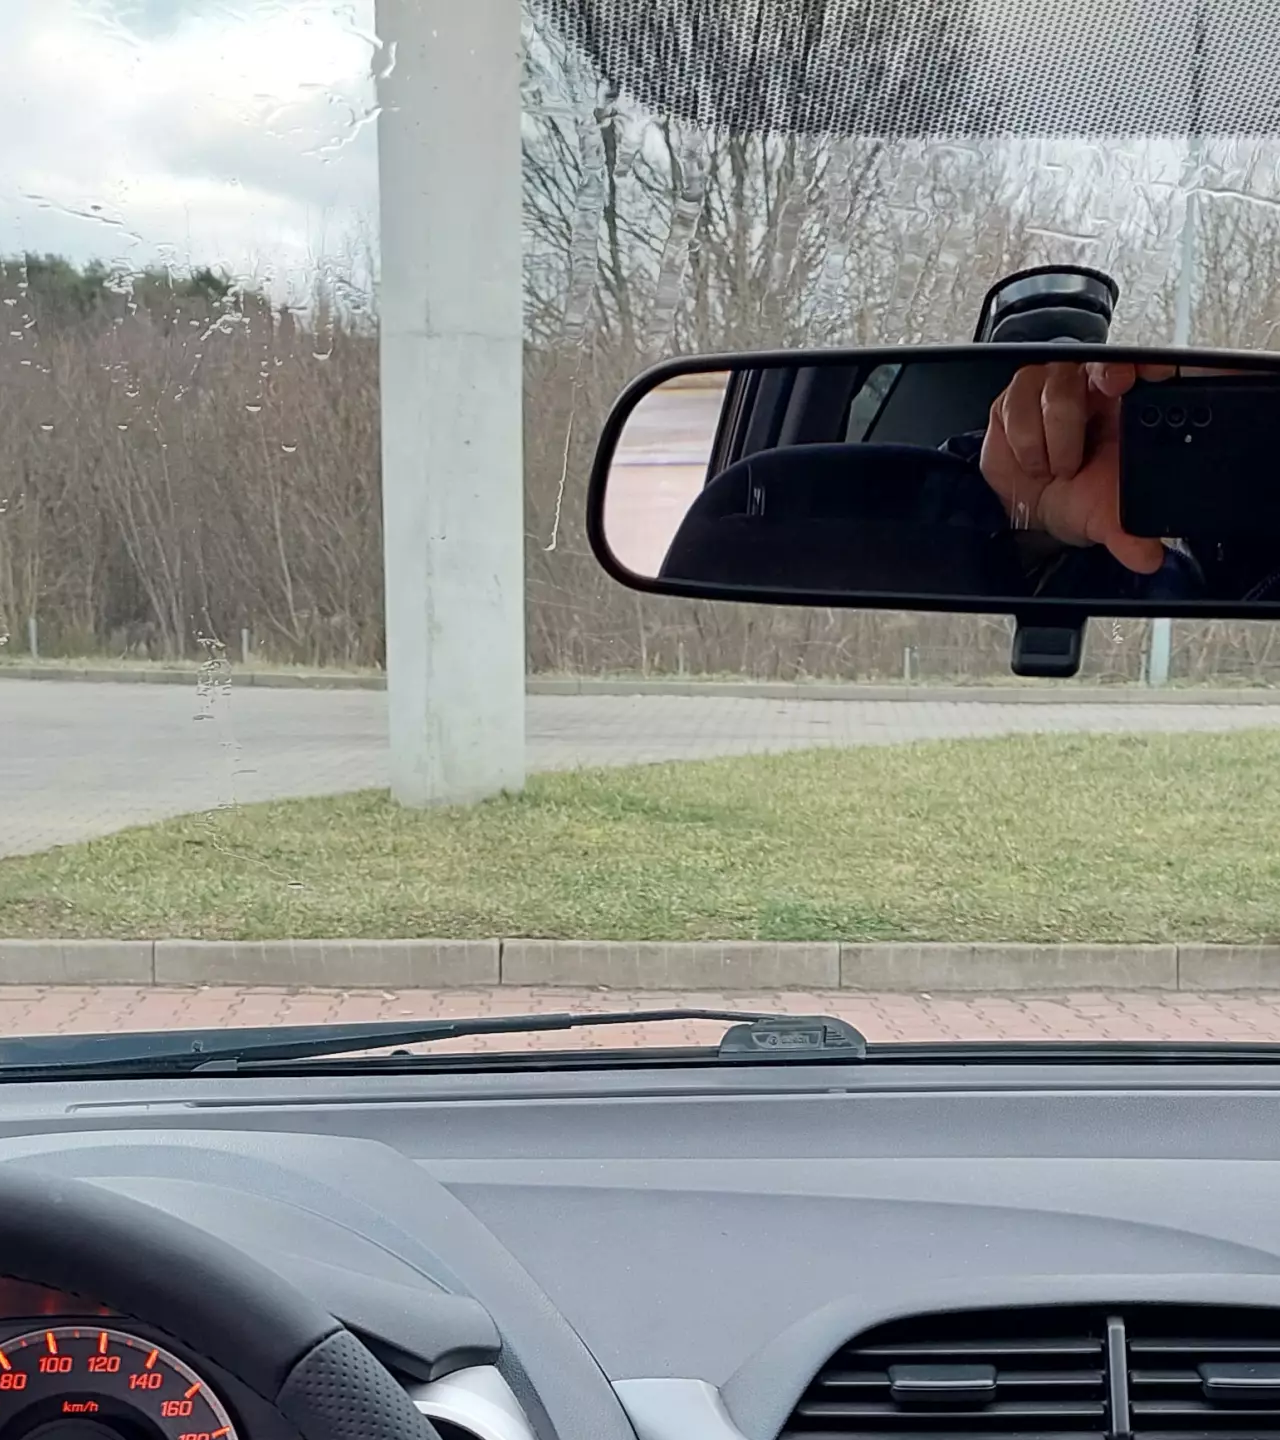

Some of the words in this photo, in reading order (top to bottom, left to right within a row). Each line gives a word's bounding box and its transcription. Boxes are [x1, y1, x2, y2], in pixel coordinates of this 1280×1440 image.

[39, 1355, 72, 1373] 100
[87, 1355, 120, 1373] 120
[0, 1373, 27, 1390] 80
[129, 1372, 163, 1389] 140
[62, 1401, 99, 1413] km/h
[160, 1400, 193, 1417] 160
